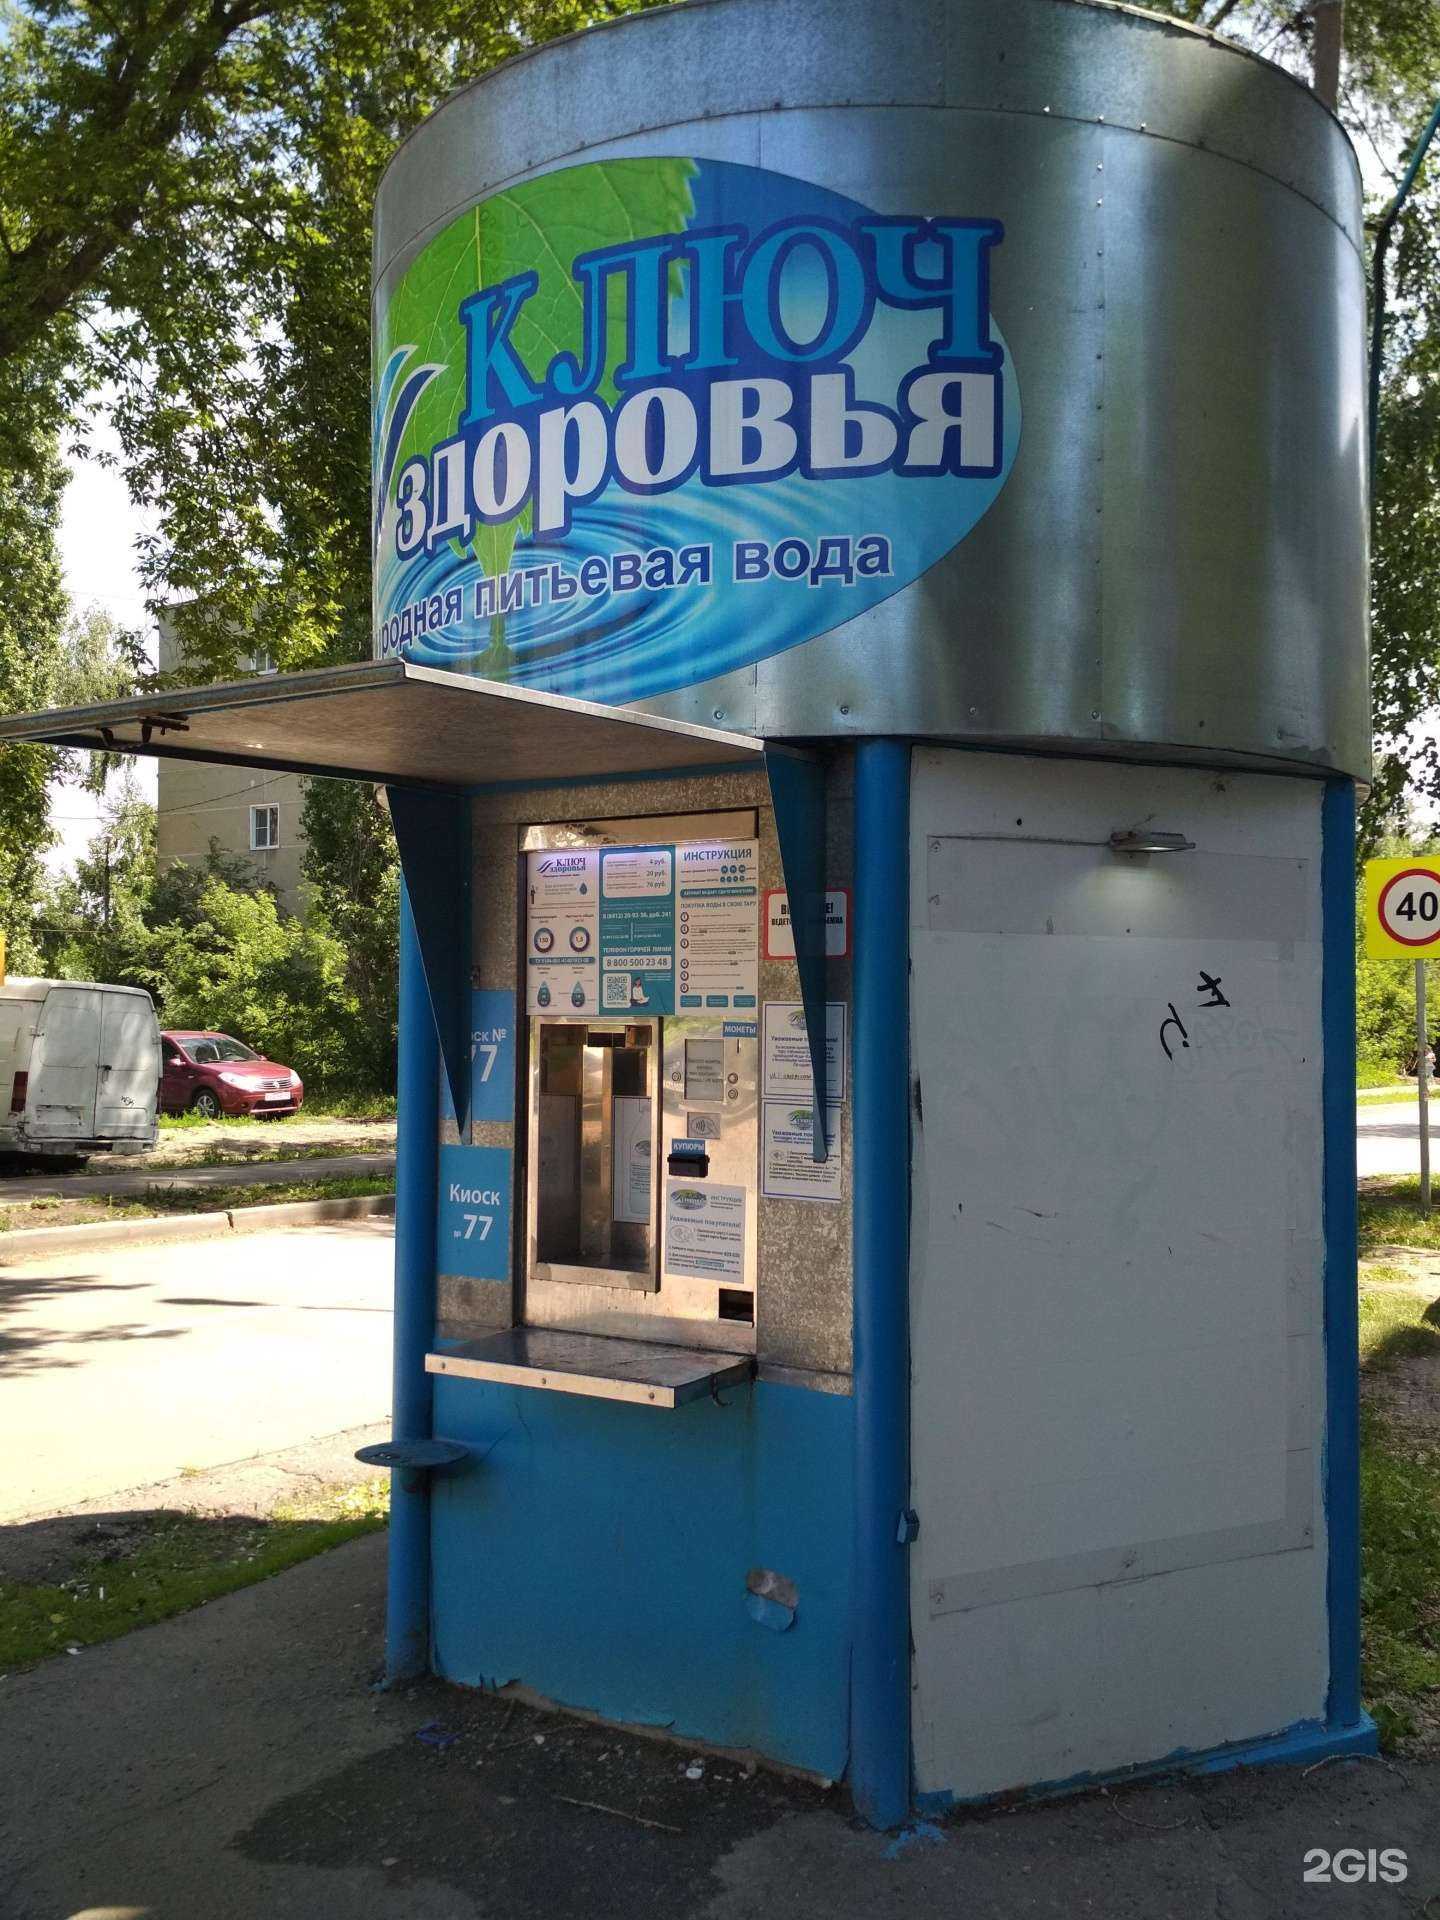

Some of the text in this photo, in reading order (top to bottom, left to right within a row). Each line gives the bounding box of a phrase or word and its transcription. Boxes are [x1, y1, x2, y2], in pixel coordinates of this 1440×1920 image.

[463, 220, 1002, 425] КЛЮЧ
[397, 369, 999, 556] здоровья
[474, 543, 712, 620] питьевая
[734, 535, 892, 588] вода
[684, 848, 752, 861] ИНСТРУКЦИЯ
[1396, 892, 1438, 921] 40
[607, 957, 667, 967] 8 800 500 23 48
[724, 1025, 756, 1034] МОНЕТЫ
[673, 1142, 705, 1151] КУПЮРЫ
[449, 1183, 500, 1206] Киоск
[464, 1213, 493, 1241] 77
